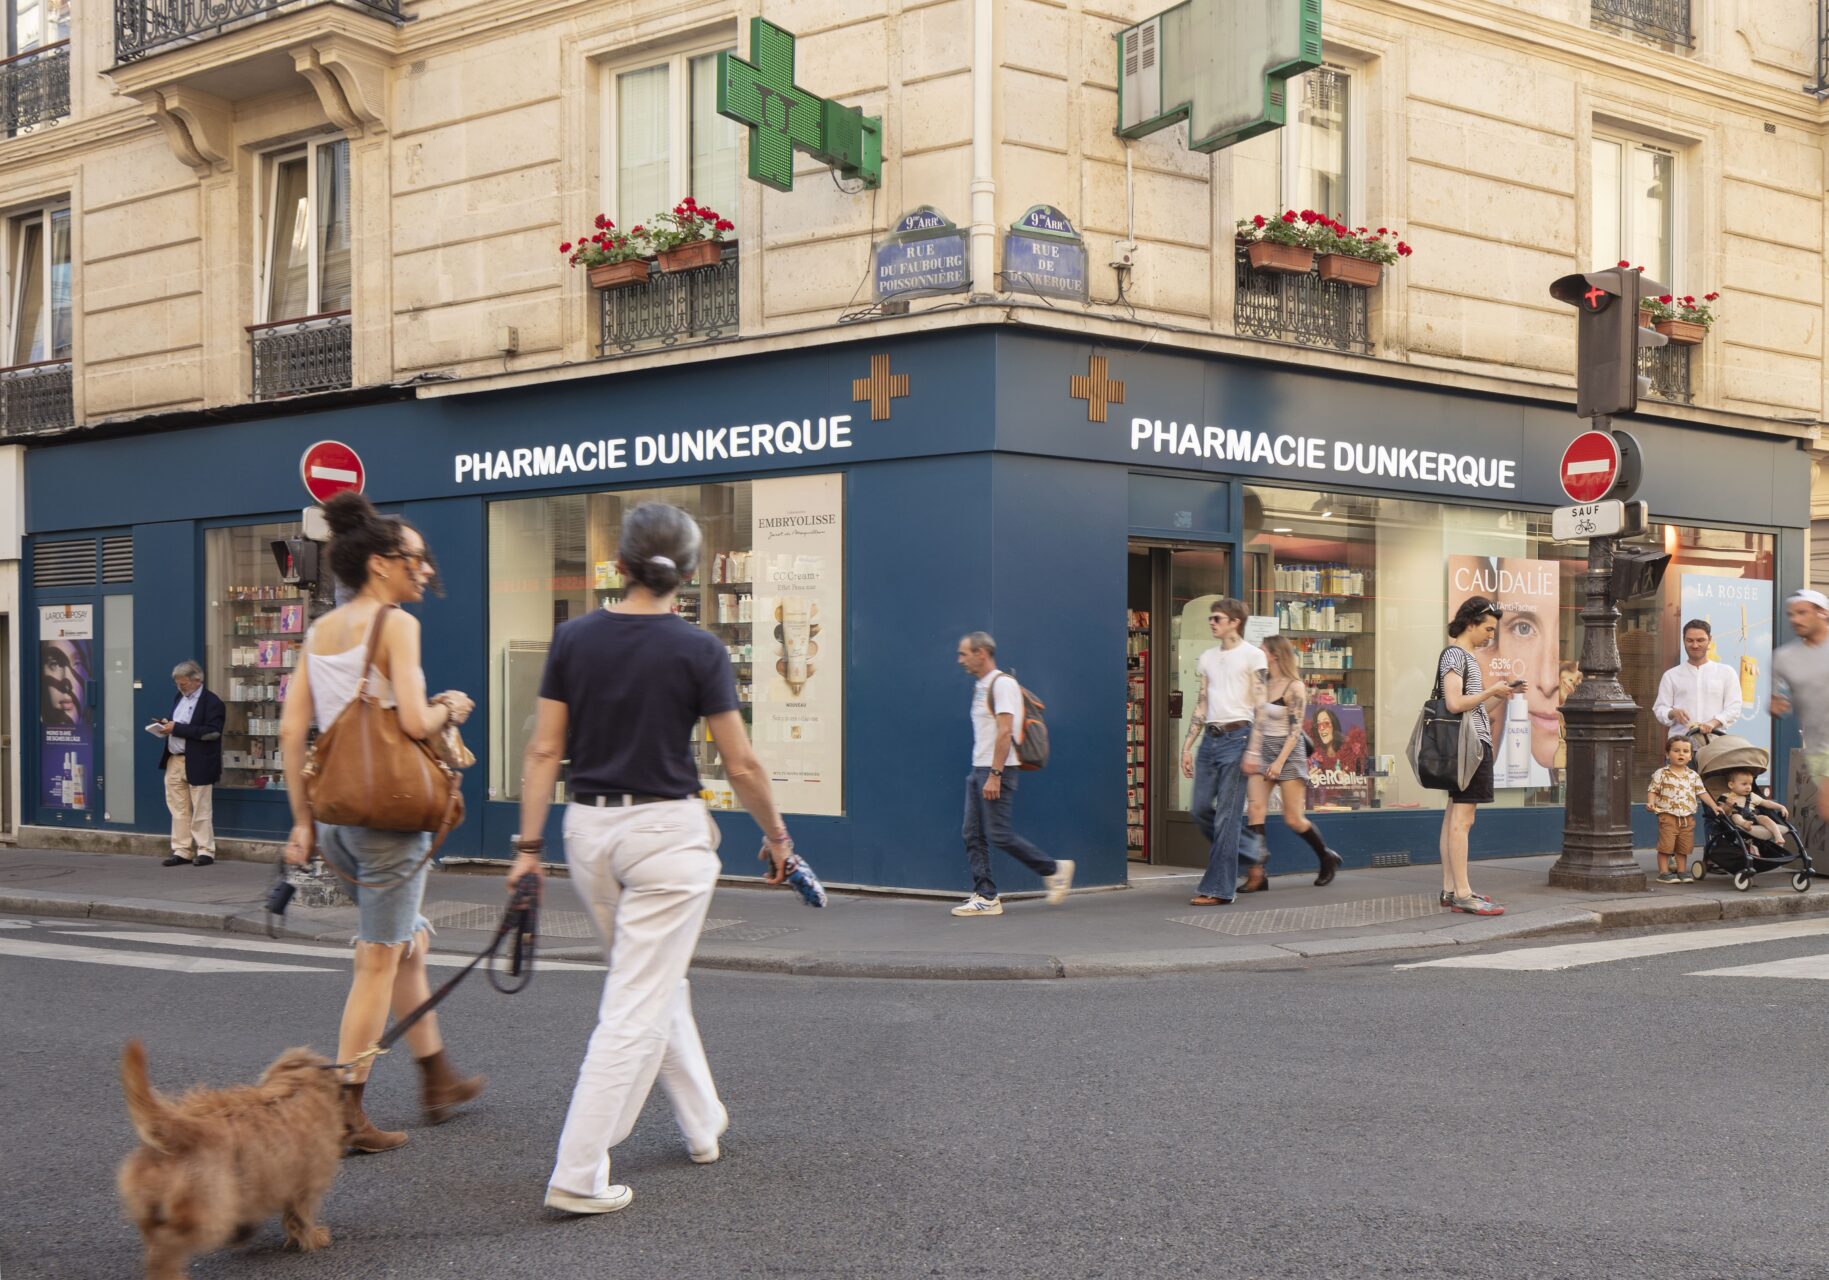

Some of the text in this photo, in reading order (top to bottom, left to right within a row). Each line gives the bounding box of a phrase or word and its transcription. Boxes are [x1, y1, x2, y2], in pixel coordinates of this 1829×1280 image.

[907, 244, 935, 258] RUE
[1032, 243, 1059, 258] RUE
[880, 255, 962, 278] DU FAUBOURG
[1038, 259, 1054, 272] DE
[879, 270, 963, 293] POISSONNIÈRE
[1010, 271, 1082, 291] DUNKERQUE
[455, 415, 852, 483] PHARMACIE DUNKERQUE
[1131, 418, 1516, 489] PHARMACIE DUNKERQUE
[1572, 505, 1599, 517] SAUF
[758, 514, 836, 529] EMBRYOLISSE
[1697, 583, 1713, 597] LA
